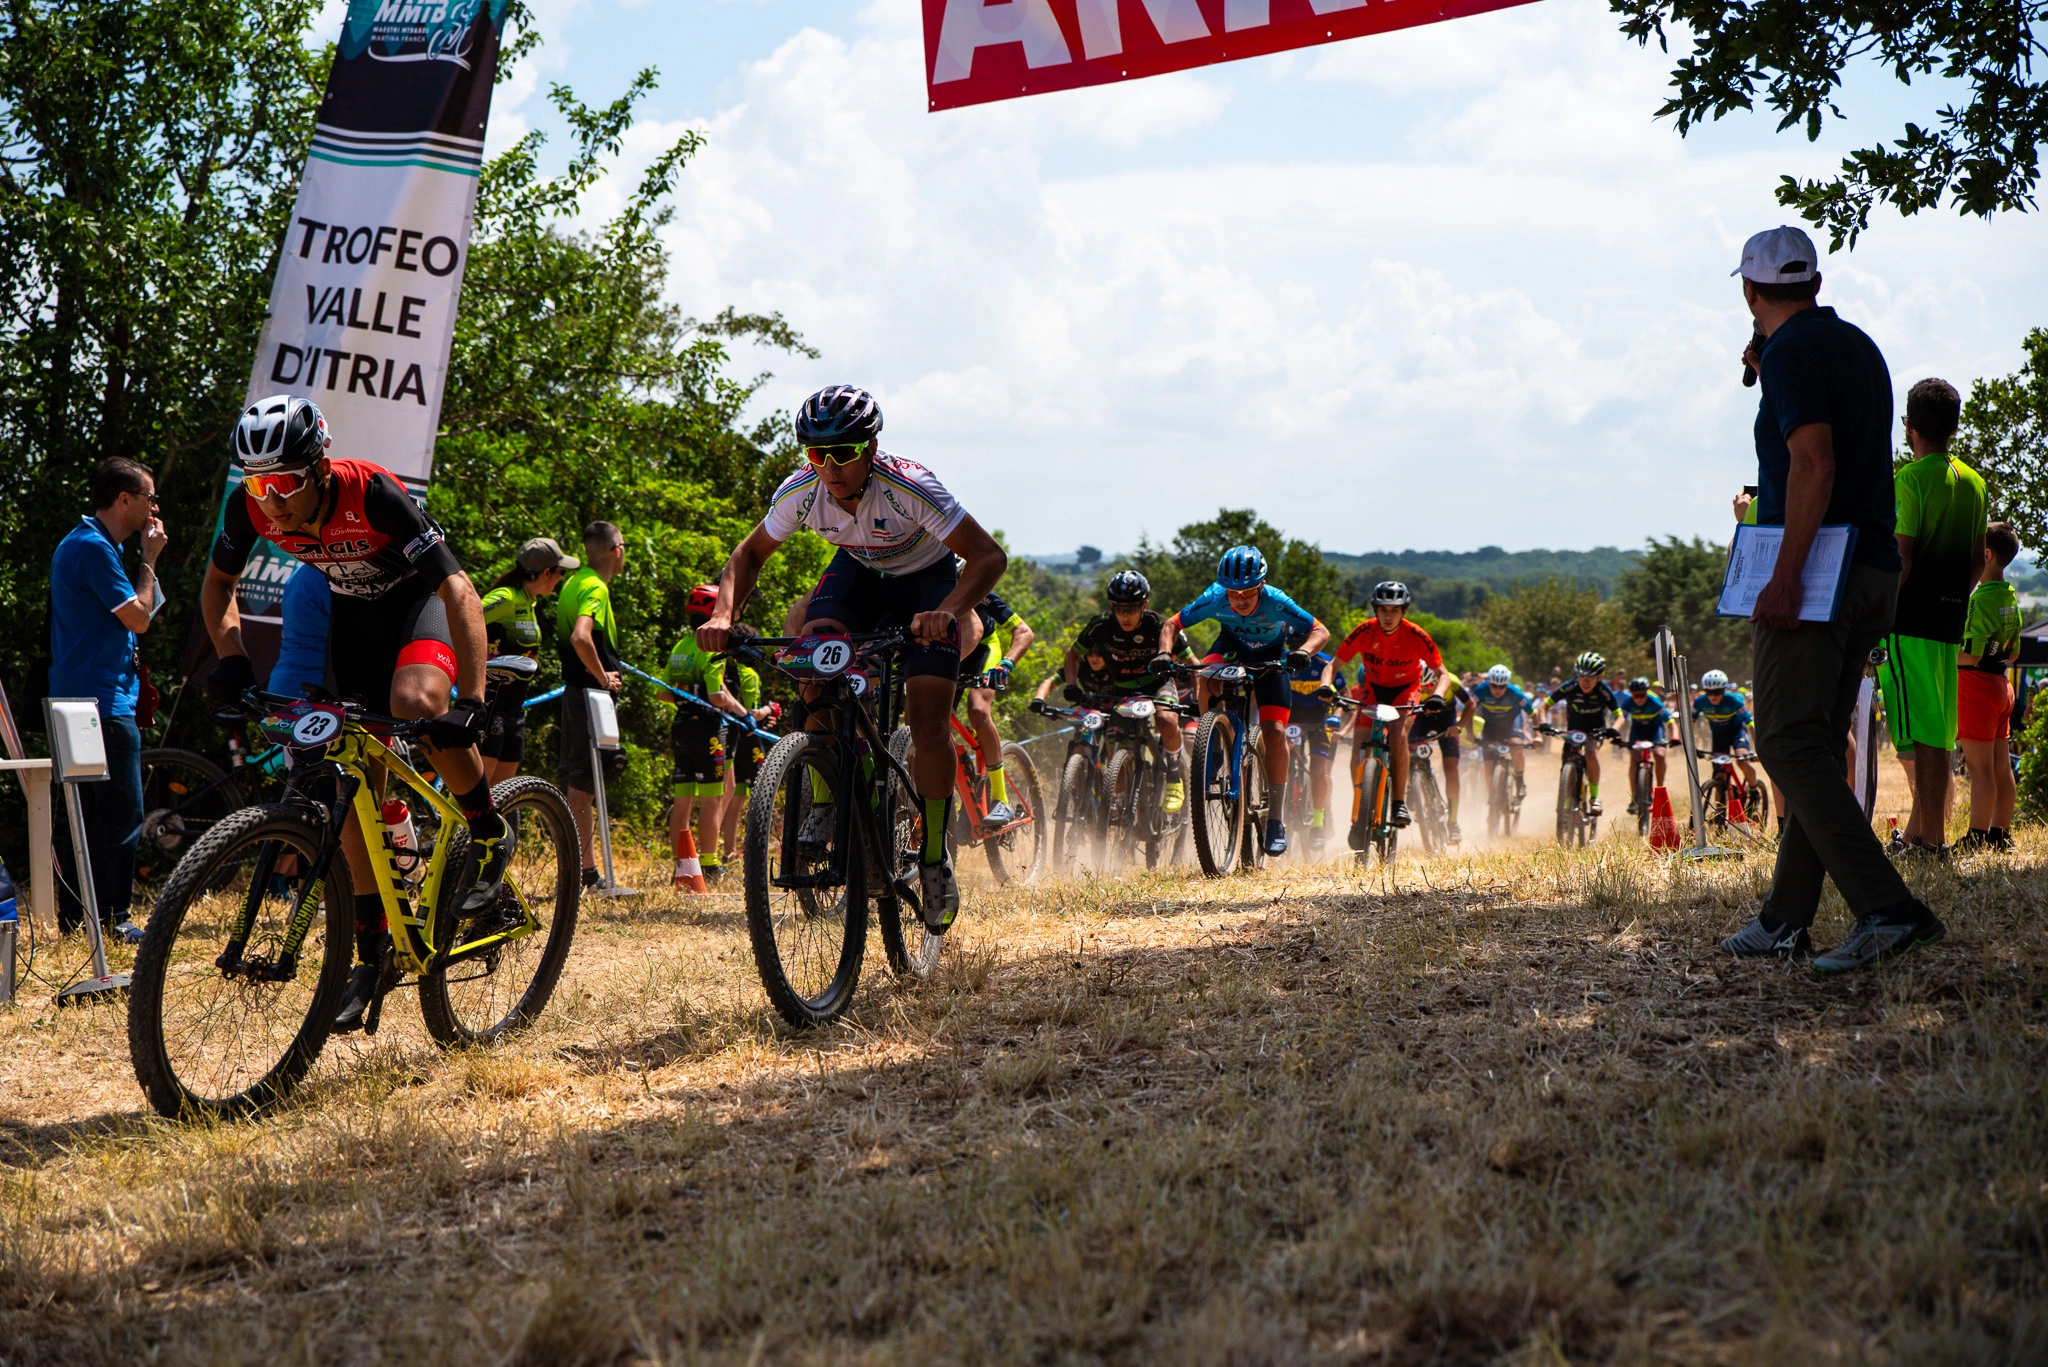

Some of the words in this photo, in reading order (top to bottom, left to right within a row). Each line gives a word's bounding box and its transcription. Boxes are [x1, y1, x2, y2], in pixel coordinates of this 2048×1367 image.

[298, 217, 459, 277] TROFEO
[307, 284, 426, 339] VALLE
[271, 343, 427, 406] D'ITRIA
[327, 539, 371, 554] GLS
[237, 583, 266, 592] AESTRI
[236, 592, 266, 601] ARTINA
[820, 646, 841, 665] 26
[1225, 667, 1237, 676] 27
[1136, 703, 1147, 712] 24
[301, 715, 331, 737] 23
[1086, 715, 1097, 725] 36
[283, 895, 318, 955] ROCKSHOX
